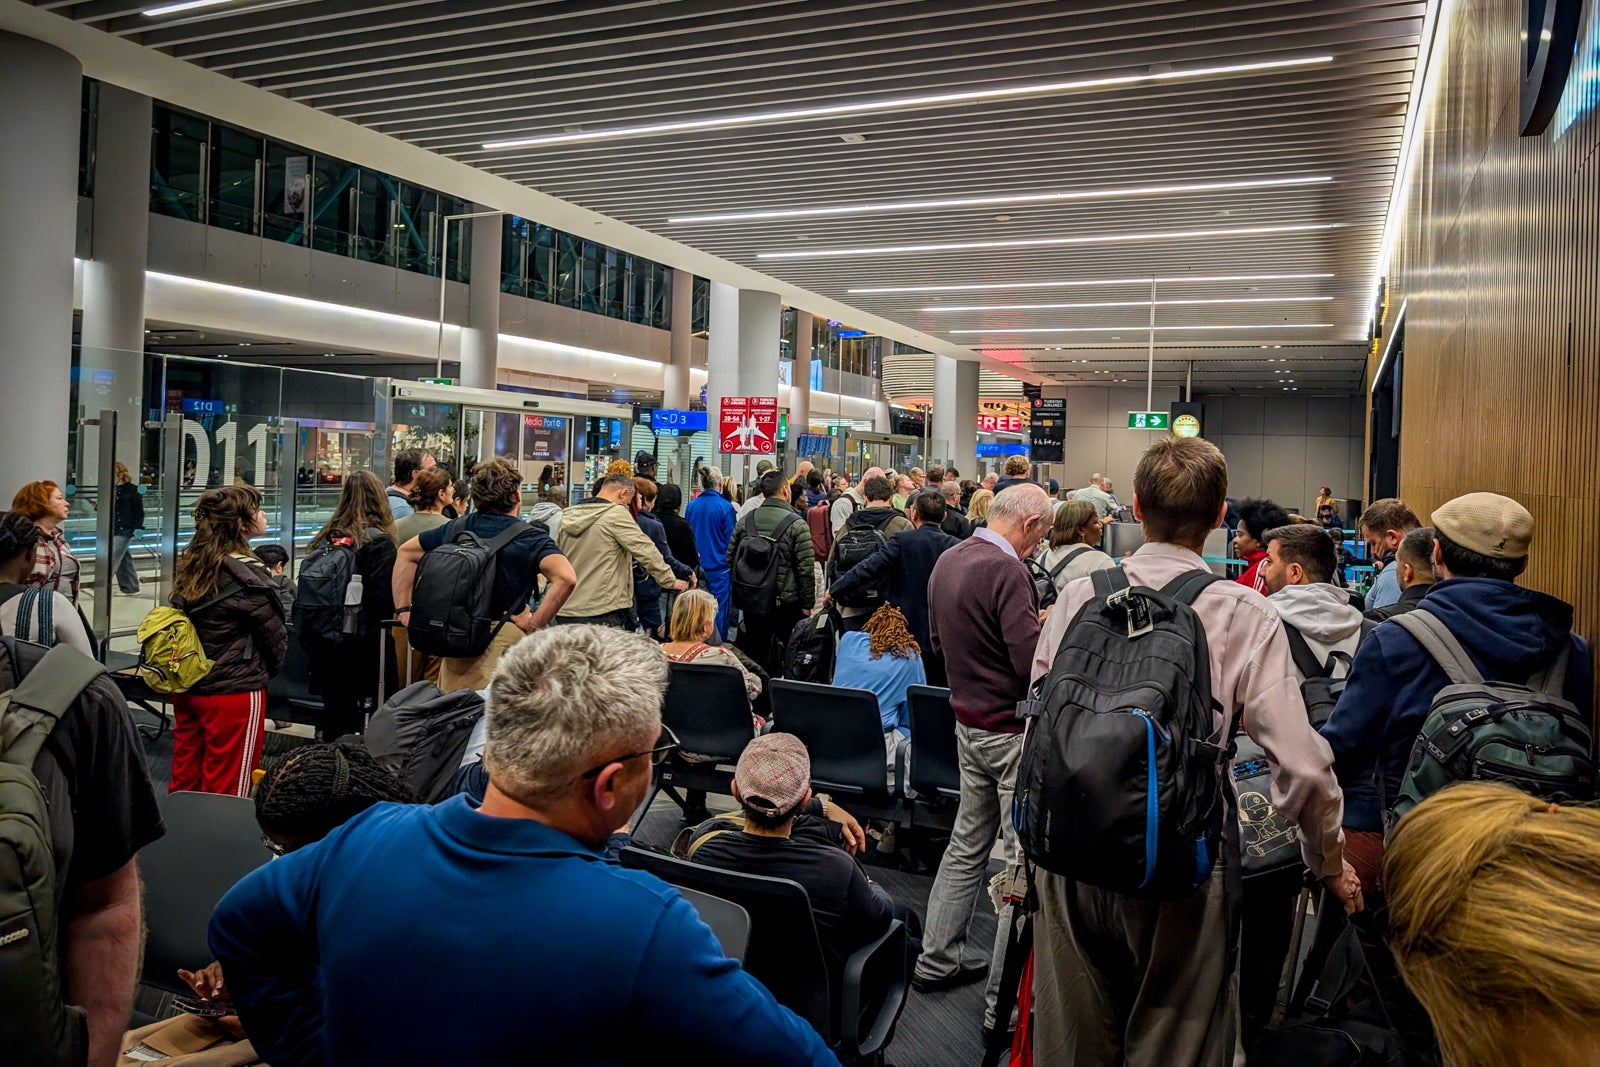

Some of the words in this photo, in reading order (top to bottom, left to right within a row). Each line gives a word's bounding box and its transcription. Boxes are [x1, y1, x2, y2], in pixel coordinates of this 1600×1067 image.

[524, 417, 542, 426] Media
[543, 418, 556, 427] Port
[670, 413, 677, 424] D
[681, 415, 686, 424] 3
[181, 419, 268, 489] D11
